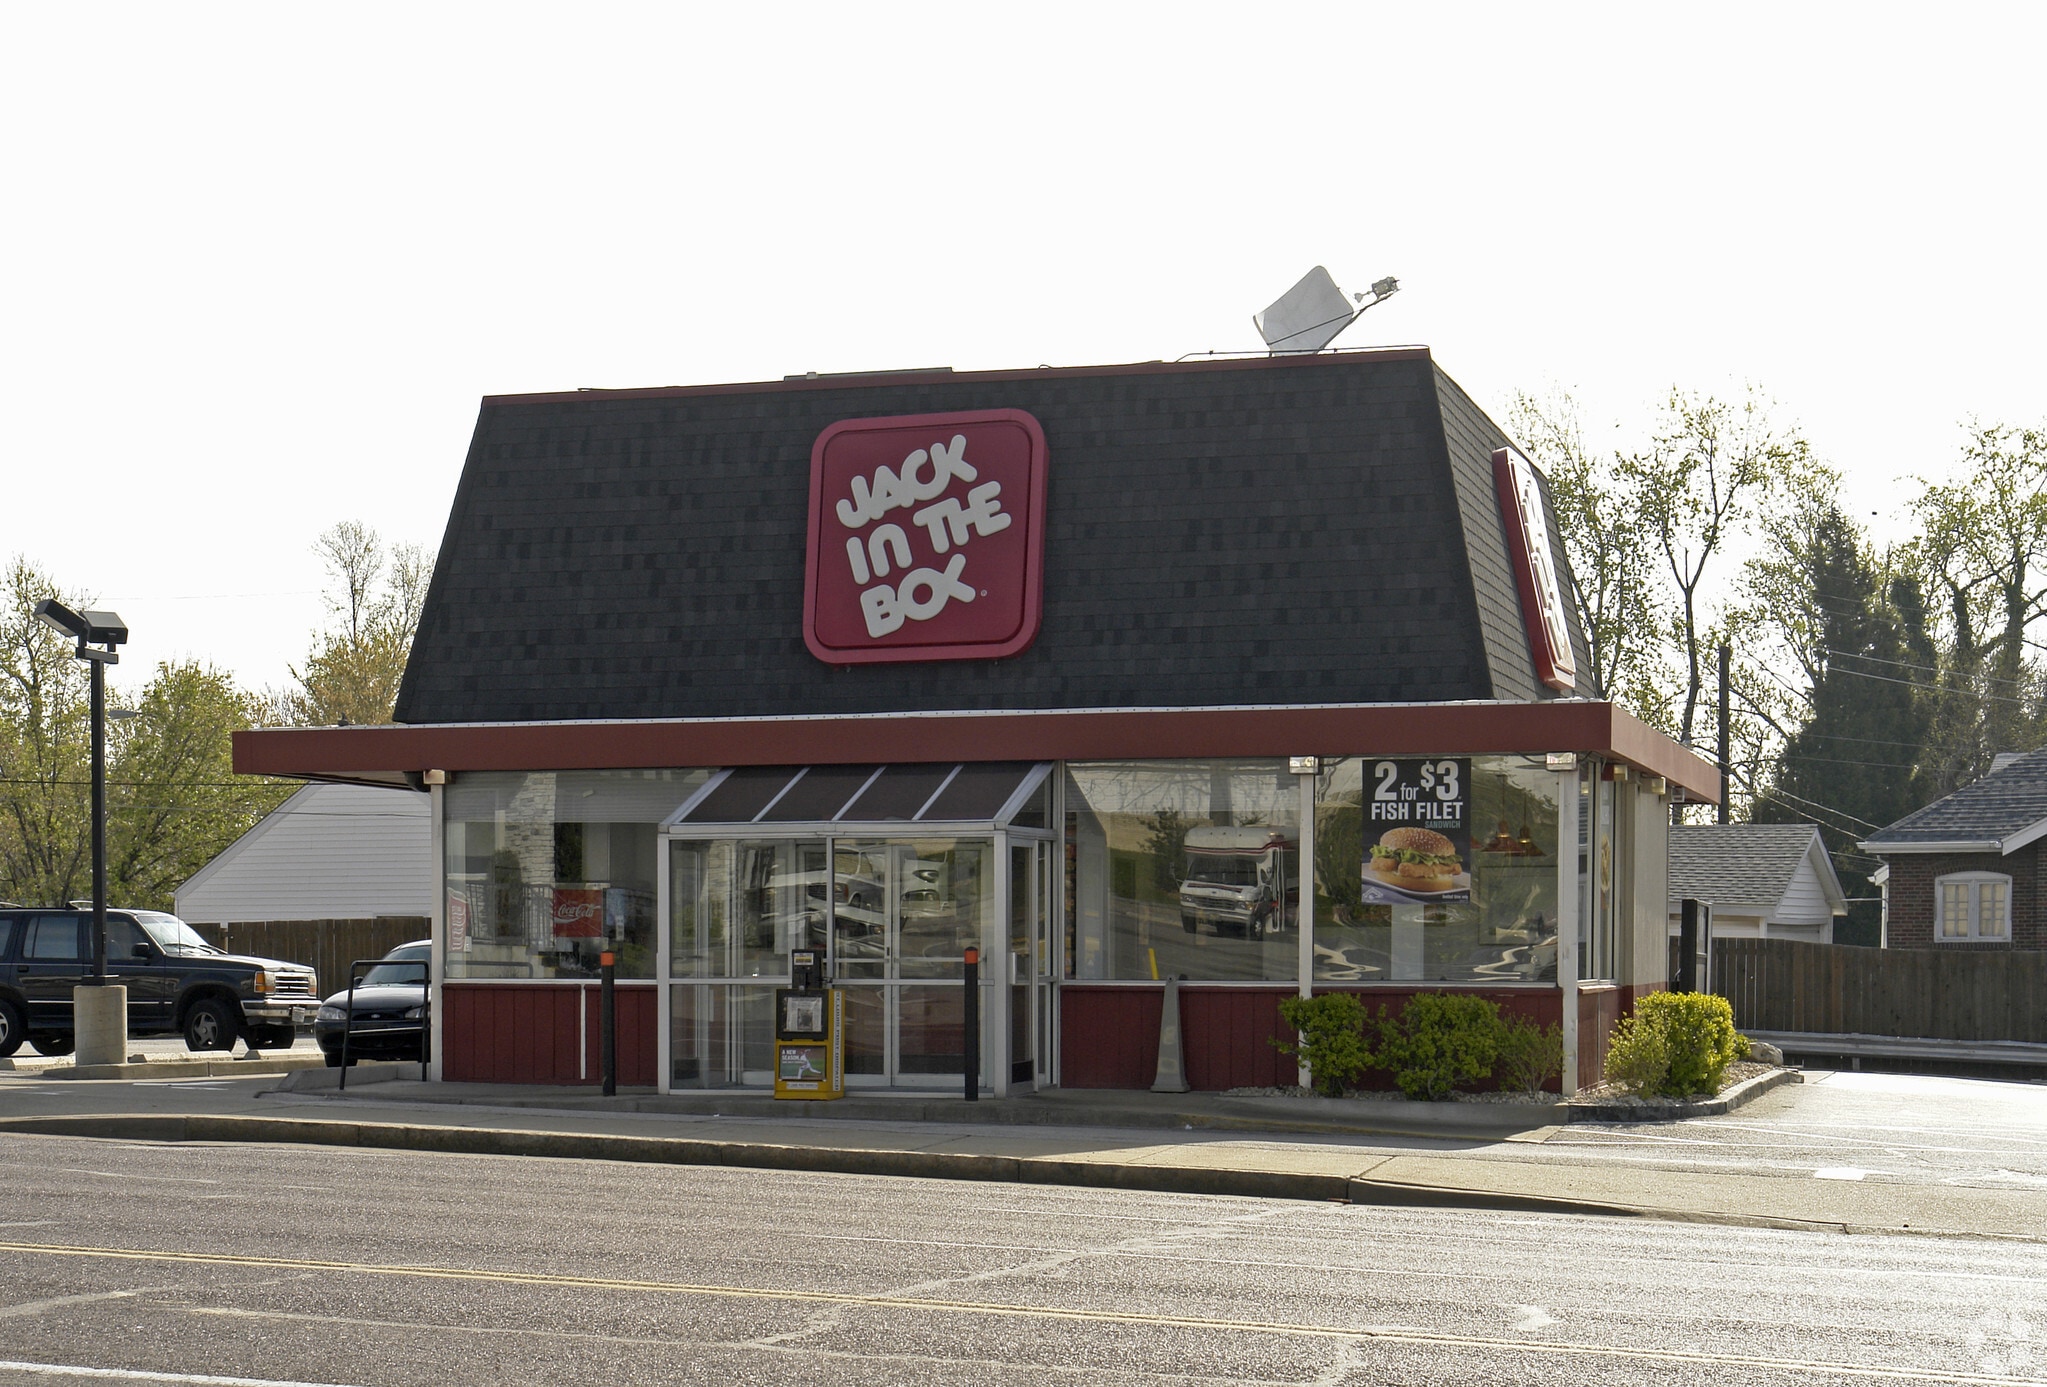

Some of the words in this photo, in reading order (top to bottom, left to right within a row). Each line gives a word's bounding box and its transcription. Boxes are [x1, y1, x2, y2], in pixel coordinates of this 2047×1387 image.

[836, 434, 978, 528] JACK
[912, 480, 1012, 554] THE
[860, 553, 976, 638] BOX
[1374, 760, 1397, 800] 2
[1400, 783, 1419, 800] for
[1371, 802, 1409, 820] FISH
[1416, 801, 1463, 820] FILET
[1425, 820, 1461, 829] SANDWICH
